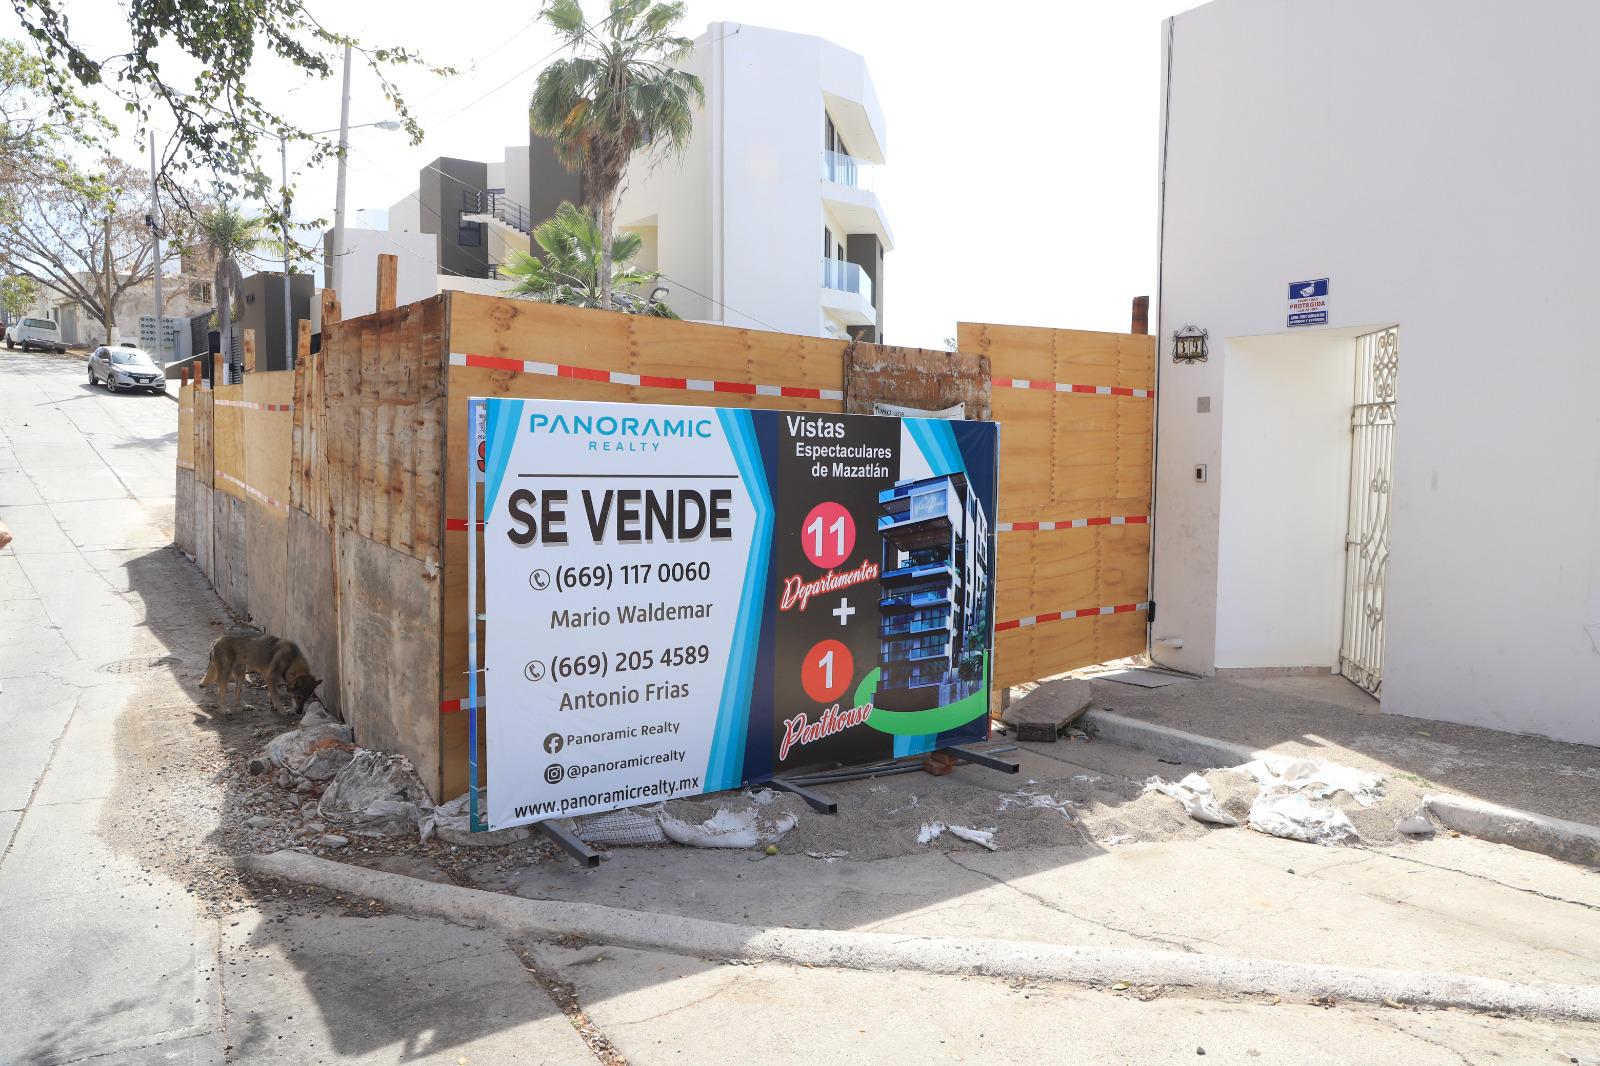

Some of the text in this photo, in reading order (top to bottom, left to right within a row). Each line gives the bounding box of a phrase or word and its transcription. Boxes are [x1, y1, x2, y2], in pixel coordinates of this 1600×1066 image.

[1289, 300, 1326, 309] PROTEGIDA
[530, 413, 712, 438] PANORAMIC
[787, 415, 846, 438] Vistas
[588, 441, 660, 451] REALTY
[795, 442, 892, 460] Espectaculares
[811, 461, 889, 478] de Mazatlán
[507, 488, 732, 545] SE VENDE
[807, 516, 845, 557] 11
[555, 561, 711, 592] (669) 117 0060
[780, 560, 879, 611] Departamentos
[550, 602, 713, 629] Mario Waldemar
[551, 644, 710, 682] (669) 205 4589
[818, 650, 834, 689] 1
[559, 680, 689, 712] Antonio Frias
[566, 721, 680, 746] Panoramic Realty
[779, 702, 875, 762] Penthouse
[566, 749, 686, 779] @panoramicrealty
[514, 776, 699, 819] www.panoramicrealty.mx
